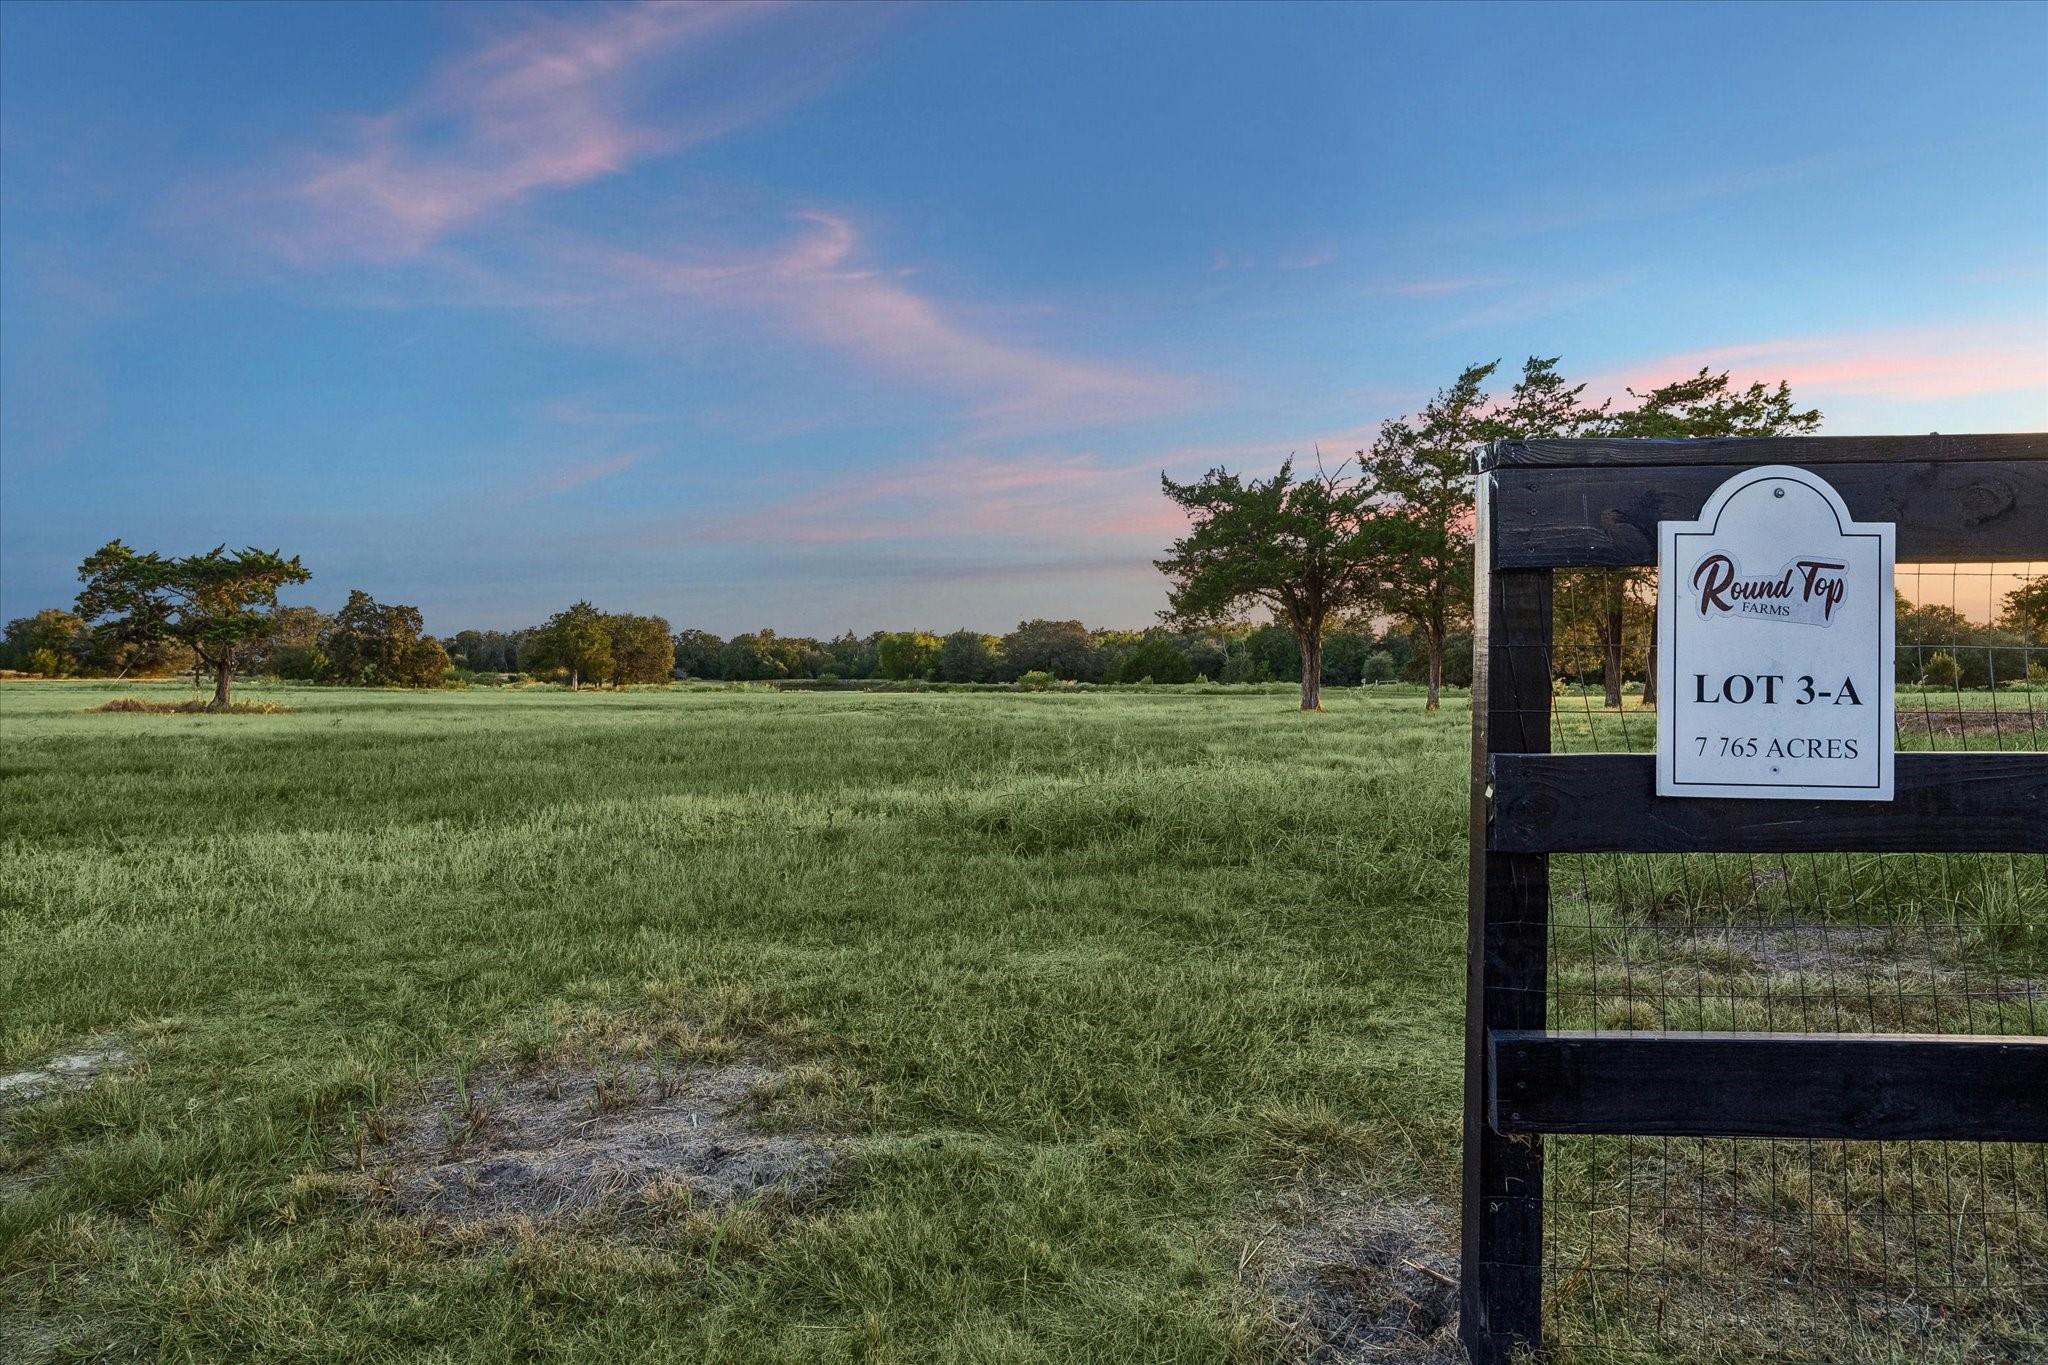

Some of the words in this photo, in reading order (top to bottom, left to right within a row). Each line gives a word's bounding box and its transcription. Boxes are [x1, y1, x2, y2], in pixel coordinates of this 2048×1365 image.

[1693, 554, 1794, 616] Round
[1796, 560, 1845, 622] Top
[1742, 602, 1790, 616] FARMS
[1693, 674, 1784, 705] LOT
[1796, 675, 1864, 706] 3-A
[1765, 738, 1858, 759] ACRES
